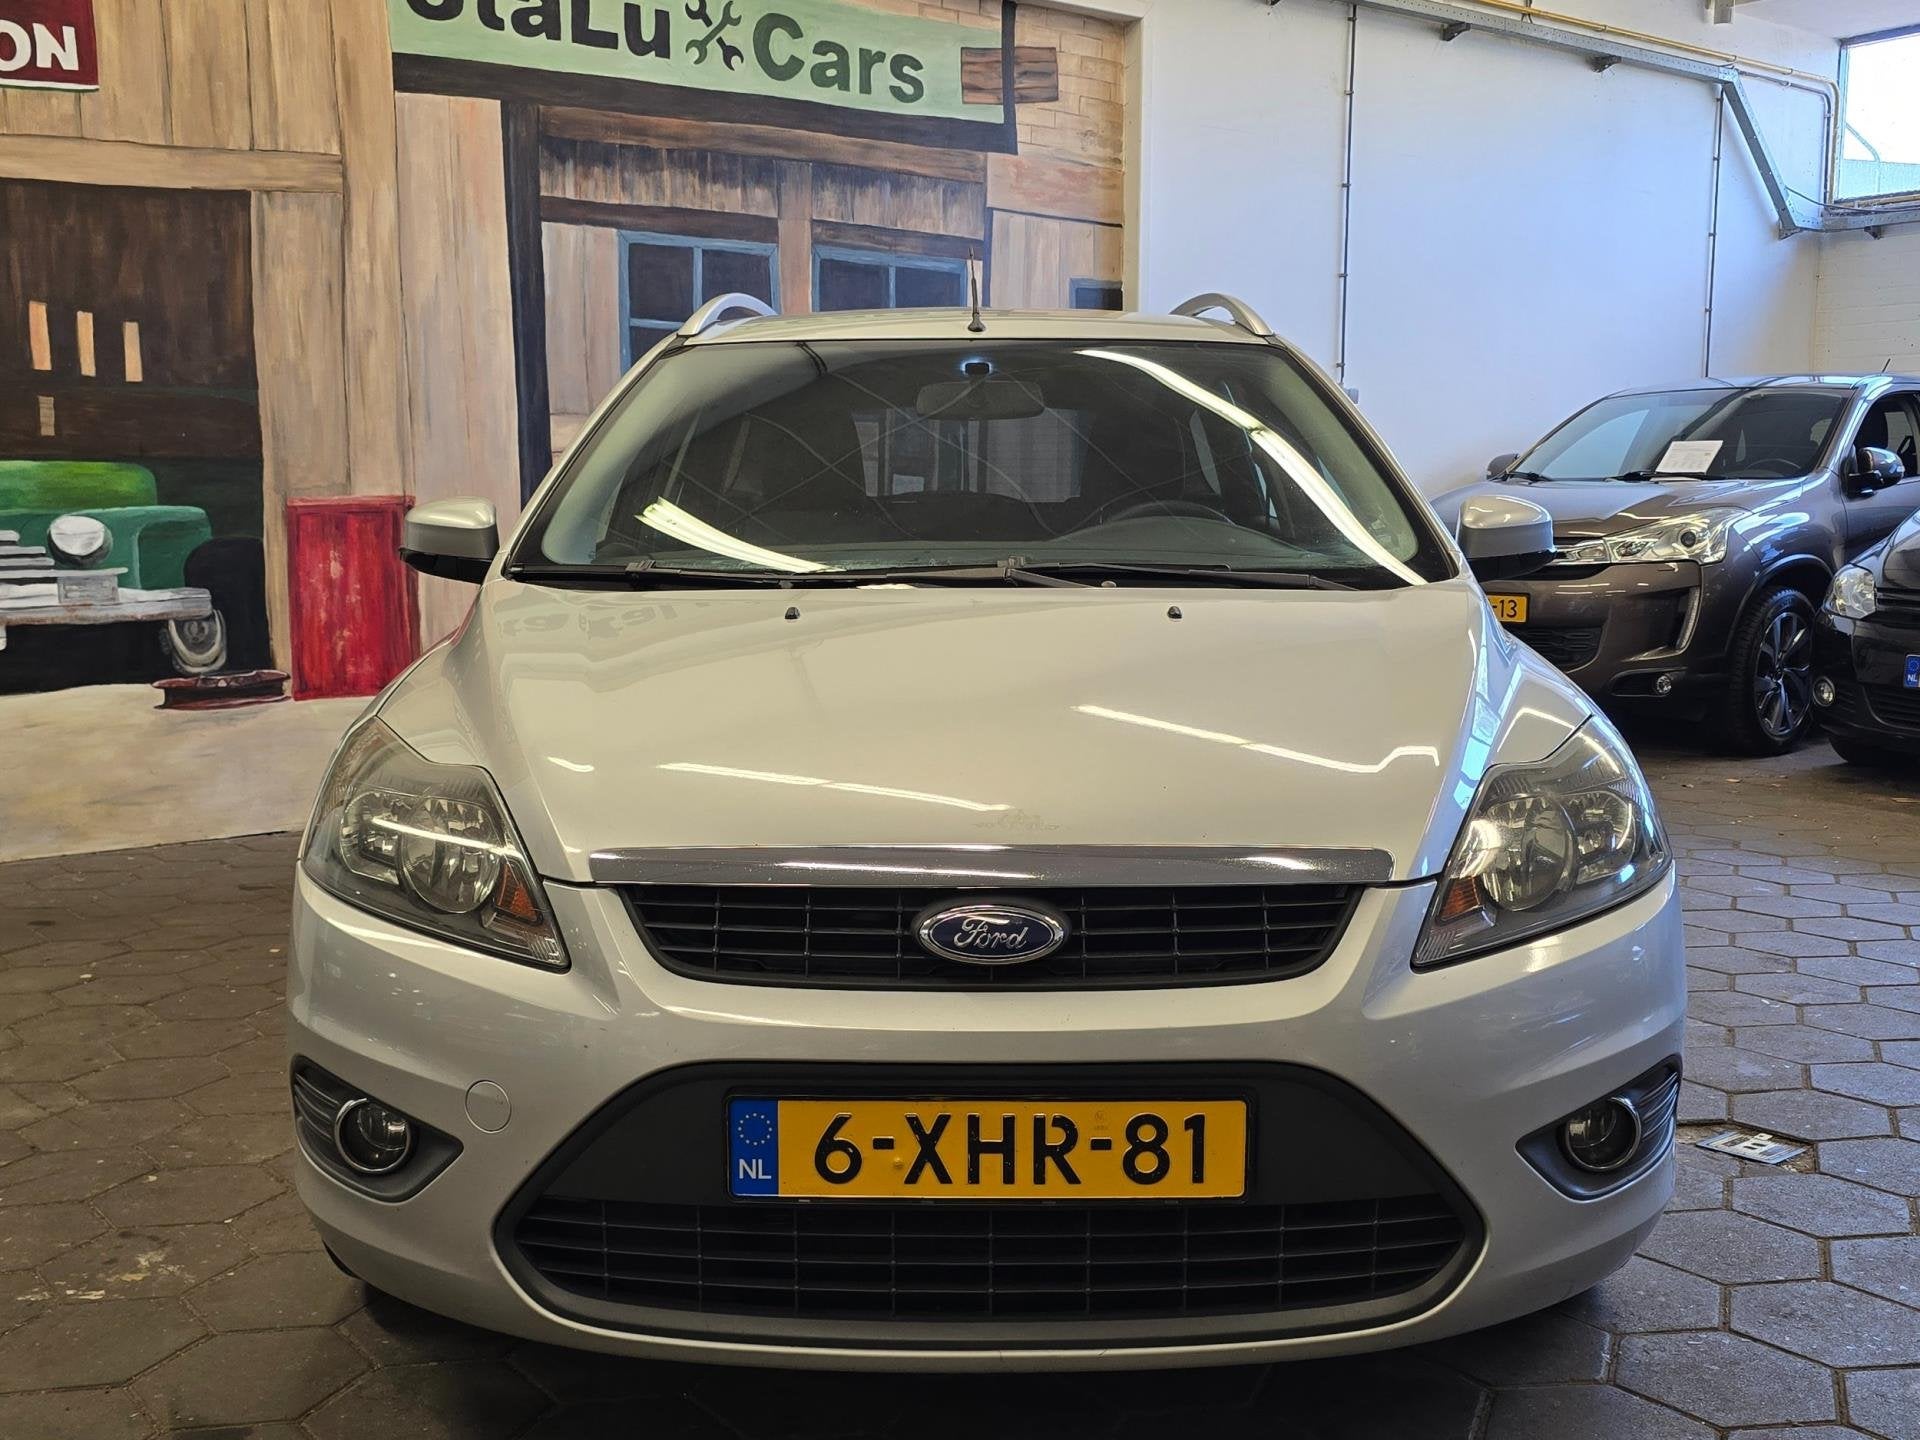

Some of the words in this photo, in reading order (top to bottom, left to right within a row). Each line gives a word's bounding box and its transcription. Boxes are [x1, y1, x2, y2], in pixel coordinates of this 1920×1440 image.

[0, 19, 79, 71] ON
[753, 13, 924, 103] Cars
[1907, 674, 1918, 682] NL
[953, 914, 1029, 949] Ford
[739, 1158, 772, 1179] NL
[814, 1112, 1205, 1185] 6-XHR-81
